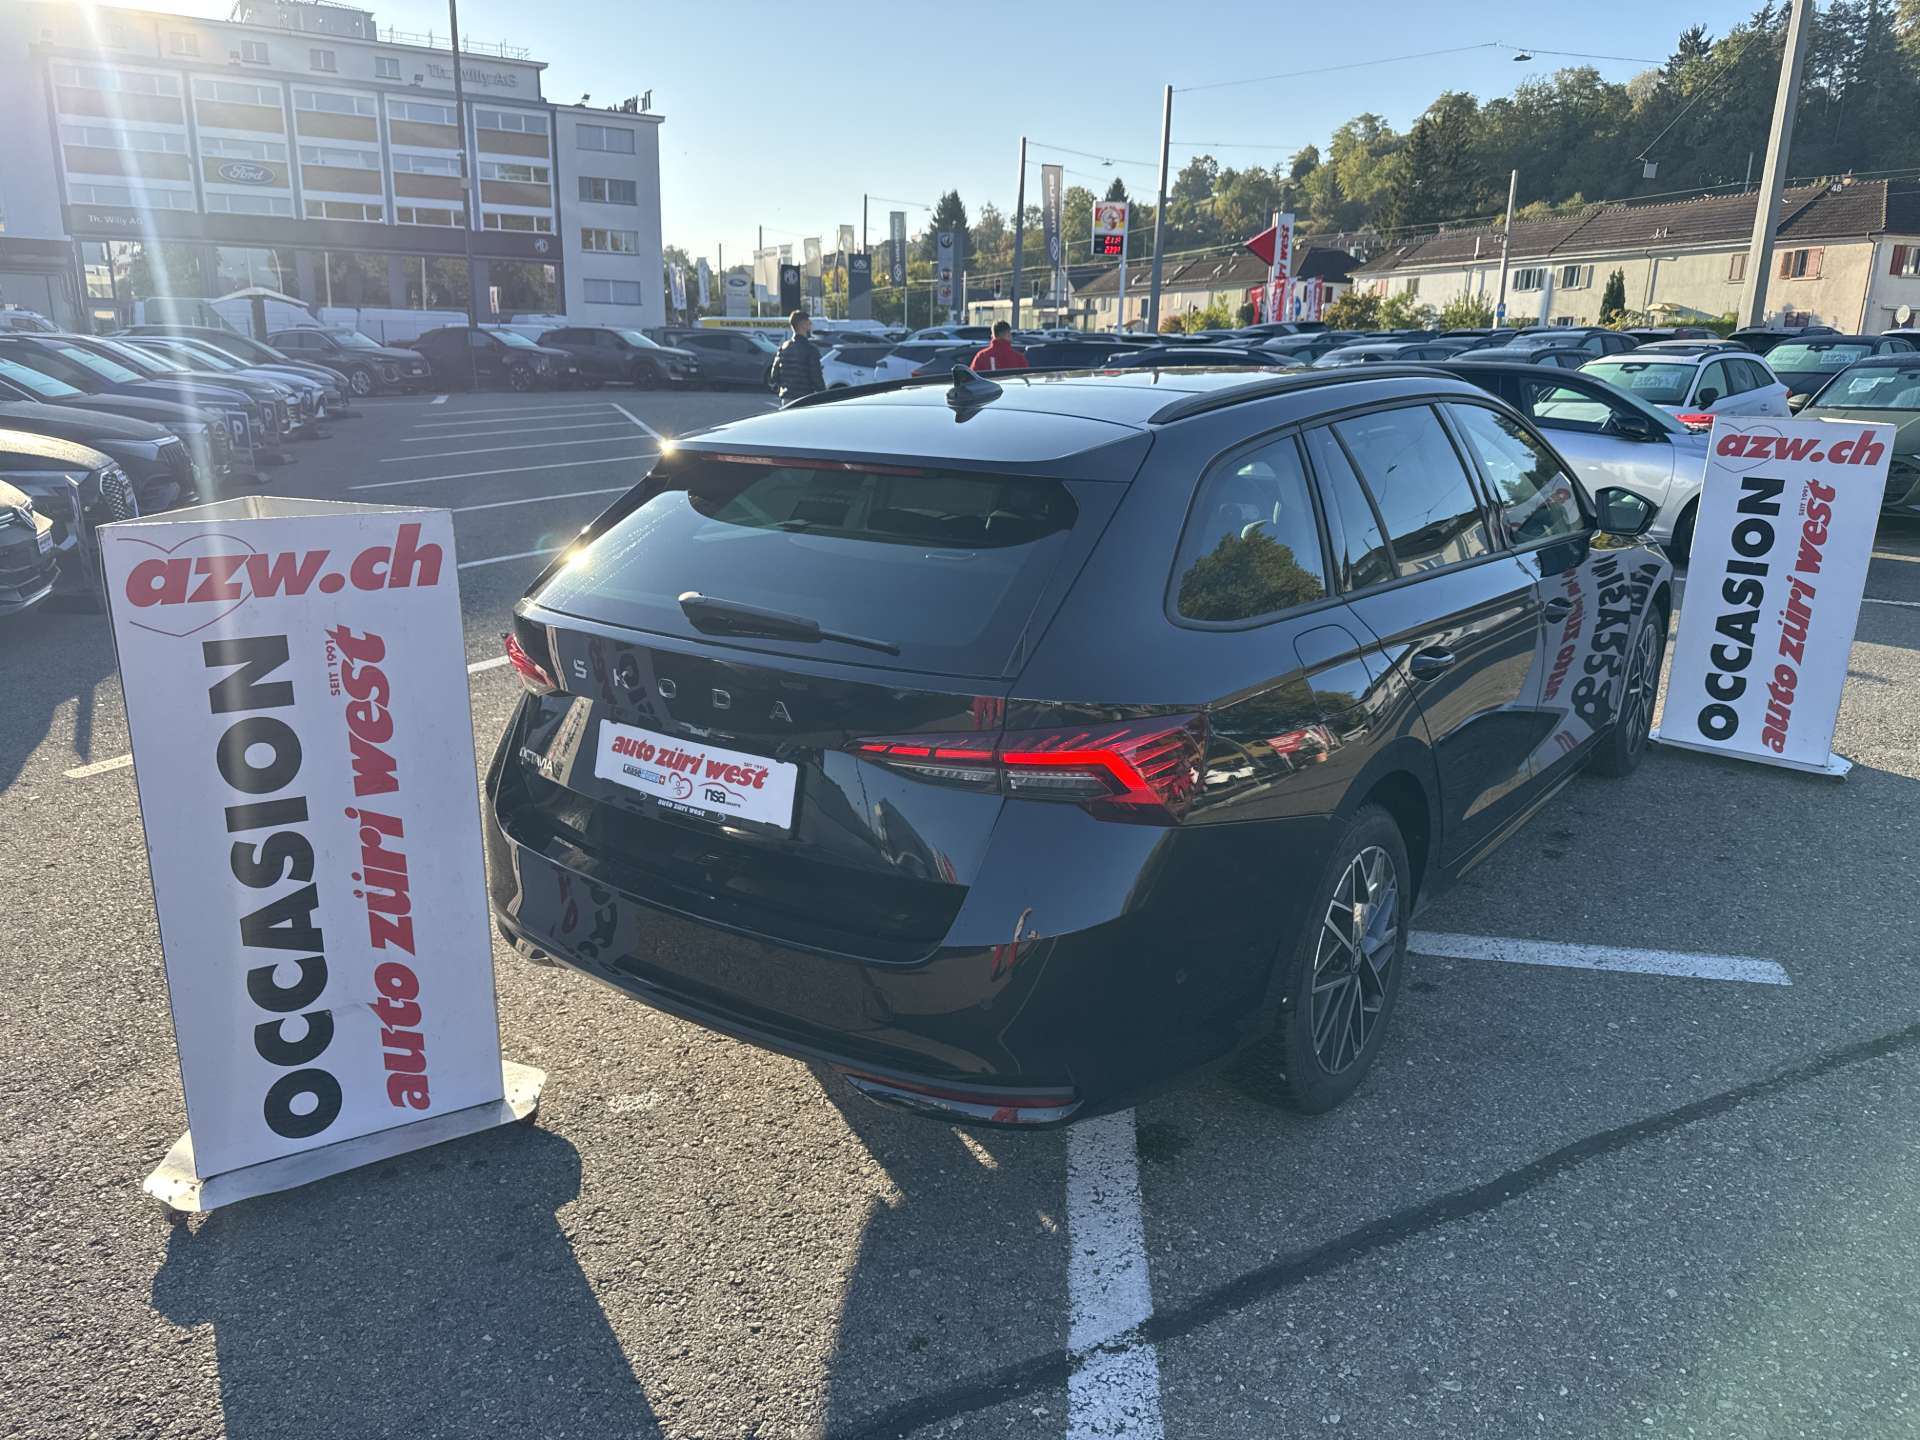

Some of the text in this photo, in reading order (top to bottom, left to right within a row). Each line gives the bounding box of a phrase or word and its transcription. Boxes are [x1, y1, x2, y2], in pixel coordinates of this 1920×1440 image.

[229, 164, 264, 181] Ford
[1716, 430, 1886, 467] azw.ch
[124, 523, 444, 608] azw.ch
[1697, 476, 1786, 742] OCCASION
[1761, 478, 1836, 754] auto züri west
[325, 639, 341, 696] SEIT 1991
[611, 735, 768, 789] auto züri west
[657, 798, 673, 808] auto
[688, 806, 706, 817] west
[704, 788, 726, 804] nsa
[202, 633, 343, 1140] OCCASION
[325, 624, 431, 1111] auto züri west
